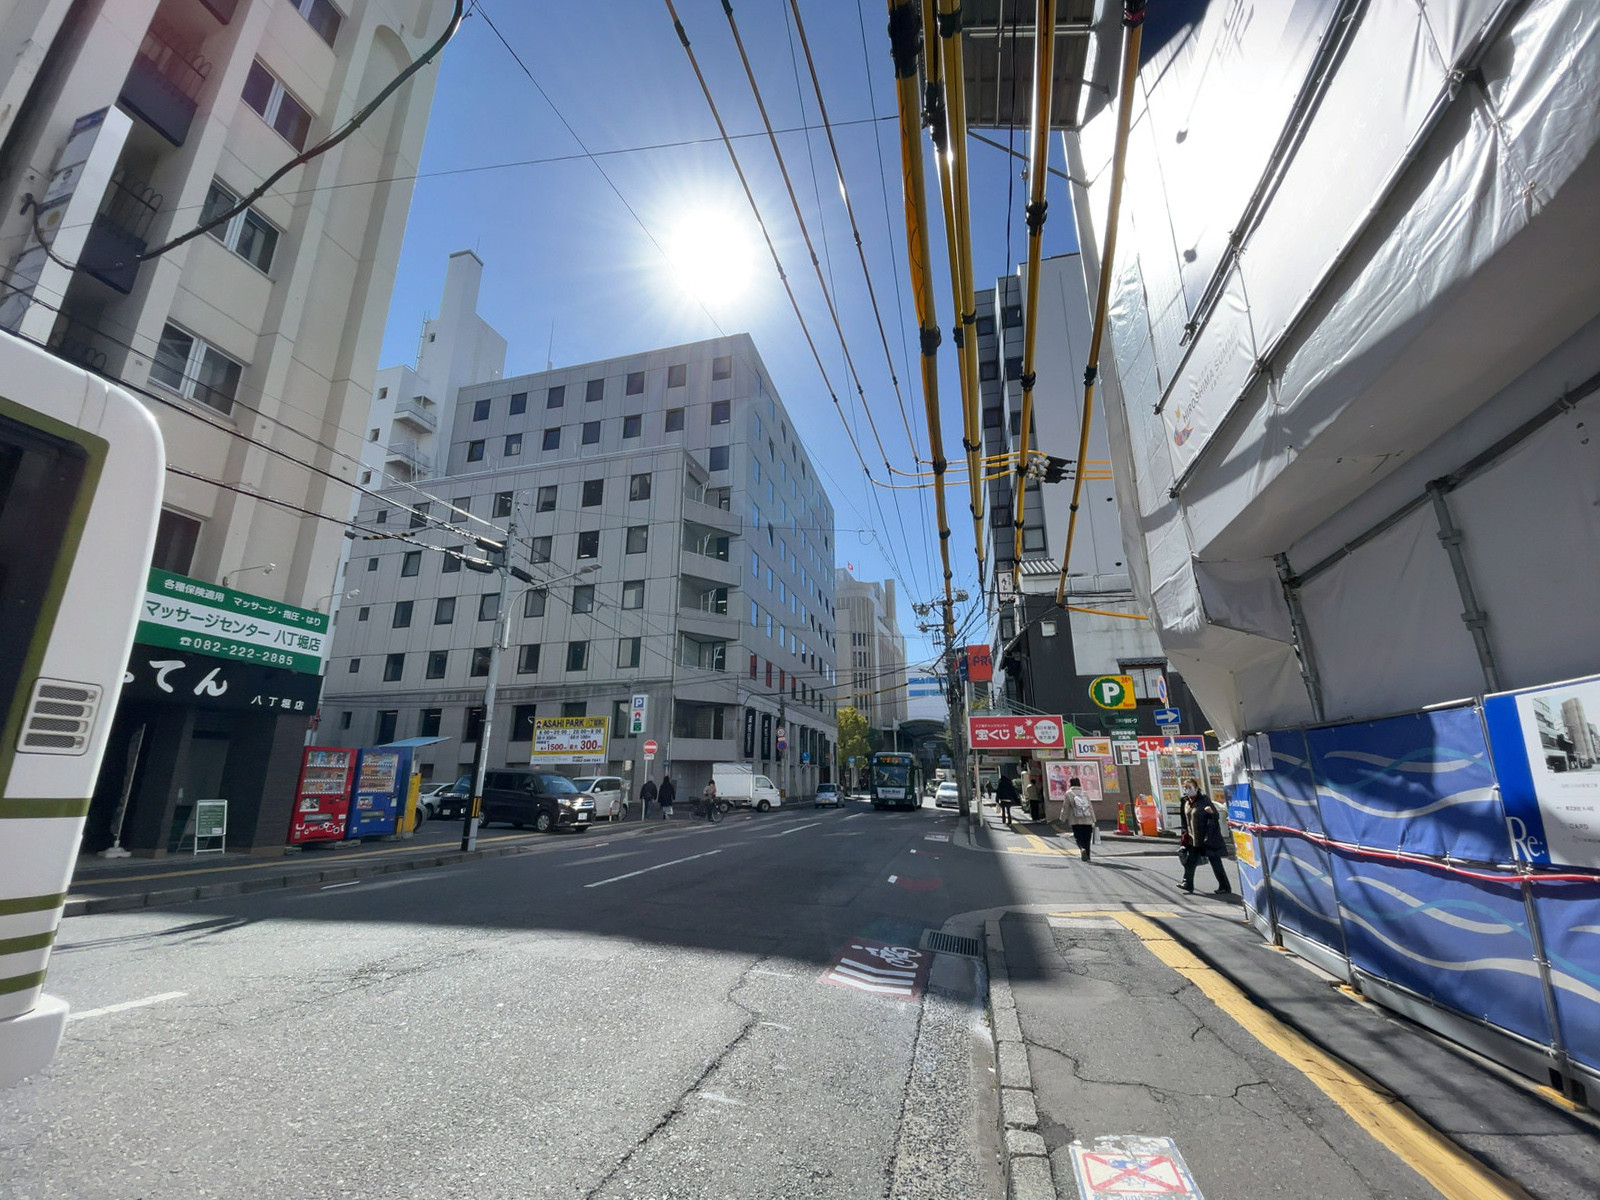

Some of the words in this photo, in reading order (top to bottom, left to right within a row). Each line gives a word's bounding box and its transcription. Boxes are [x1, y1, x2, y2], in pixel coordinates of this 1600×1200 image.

[1183, 369, 1216, 421] HIROSHIMA
[164, 579, 225, 603] 各種保険適用
[233, 597, 321, 627] マッサージ・指圧・はり
[145, 600, 270, 637] マッサージセンター
[274, 629, 321, 652] 八丁堀店
[193, 637, 293, 666] 082-222-2885
[251, 695, 305, 711] 八丁堀店
[635, 698, 643, 708] P
[1102, 682, 1120, 704] P
[543, 720, 565, 728] ASAHI
[565, 719, 585, 728] PARK
[975, 729, 1010, 741] 宝くじ
[1505, 816, 1545, 863] Re:
